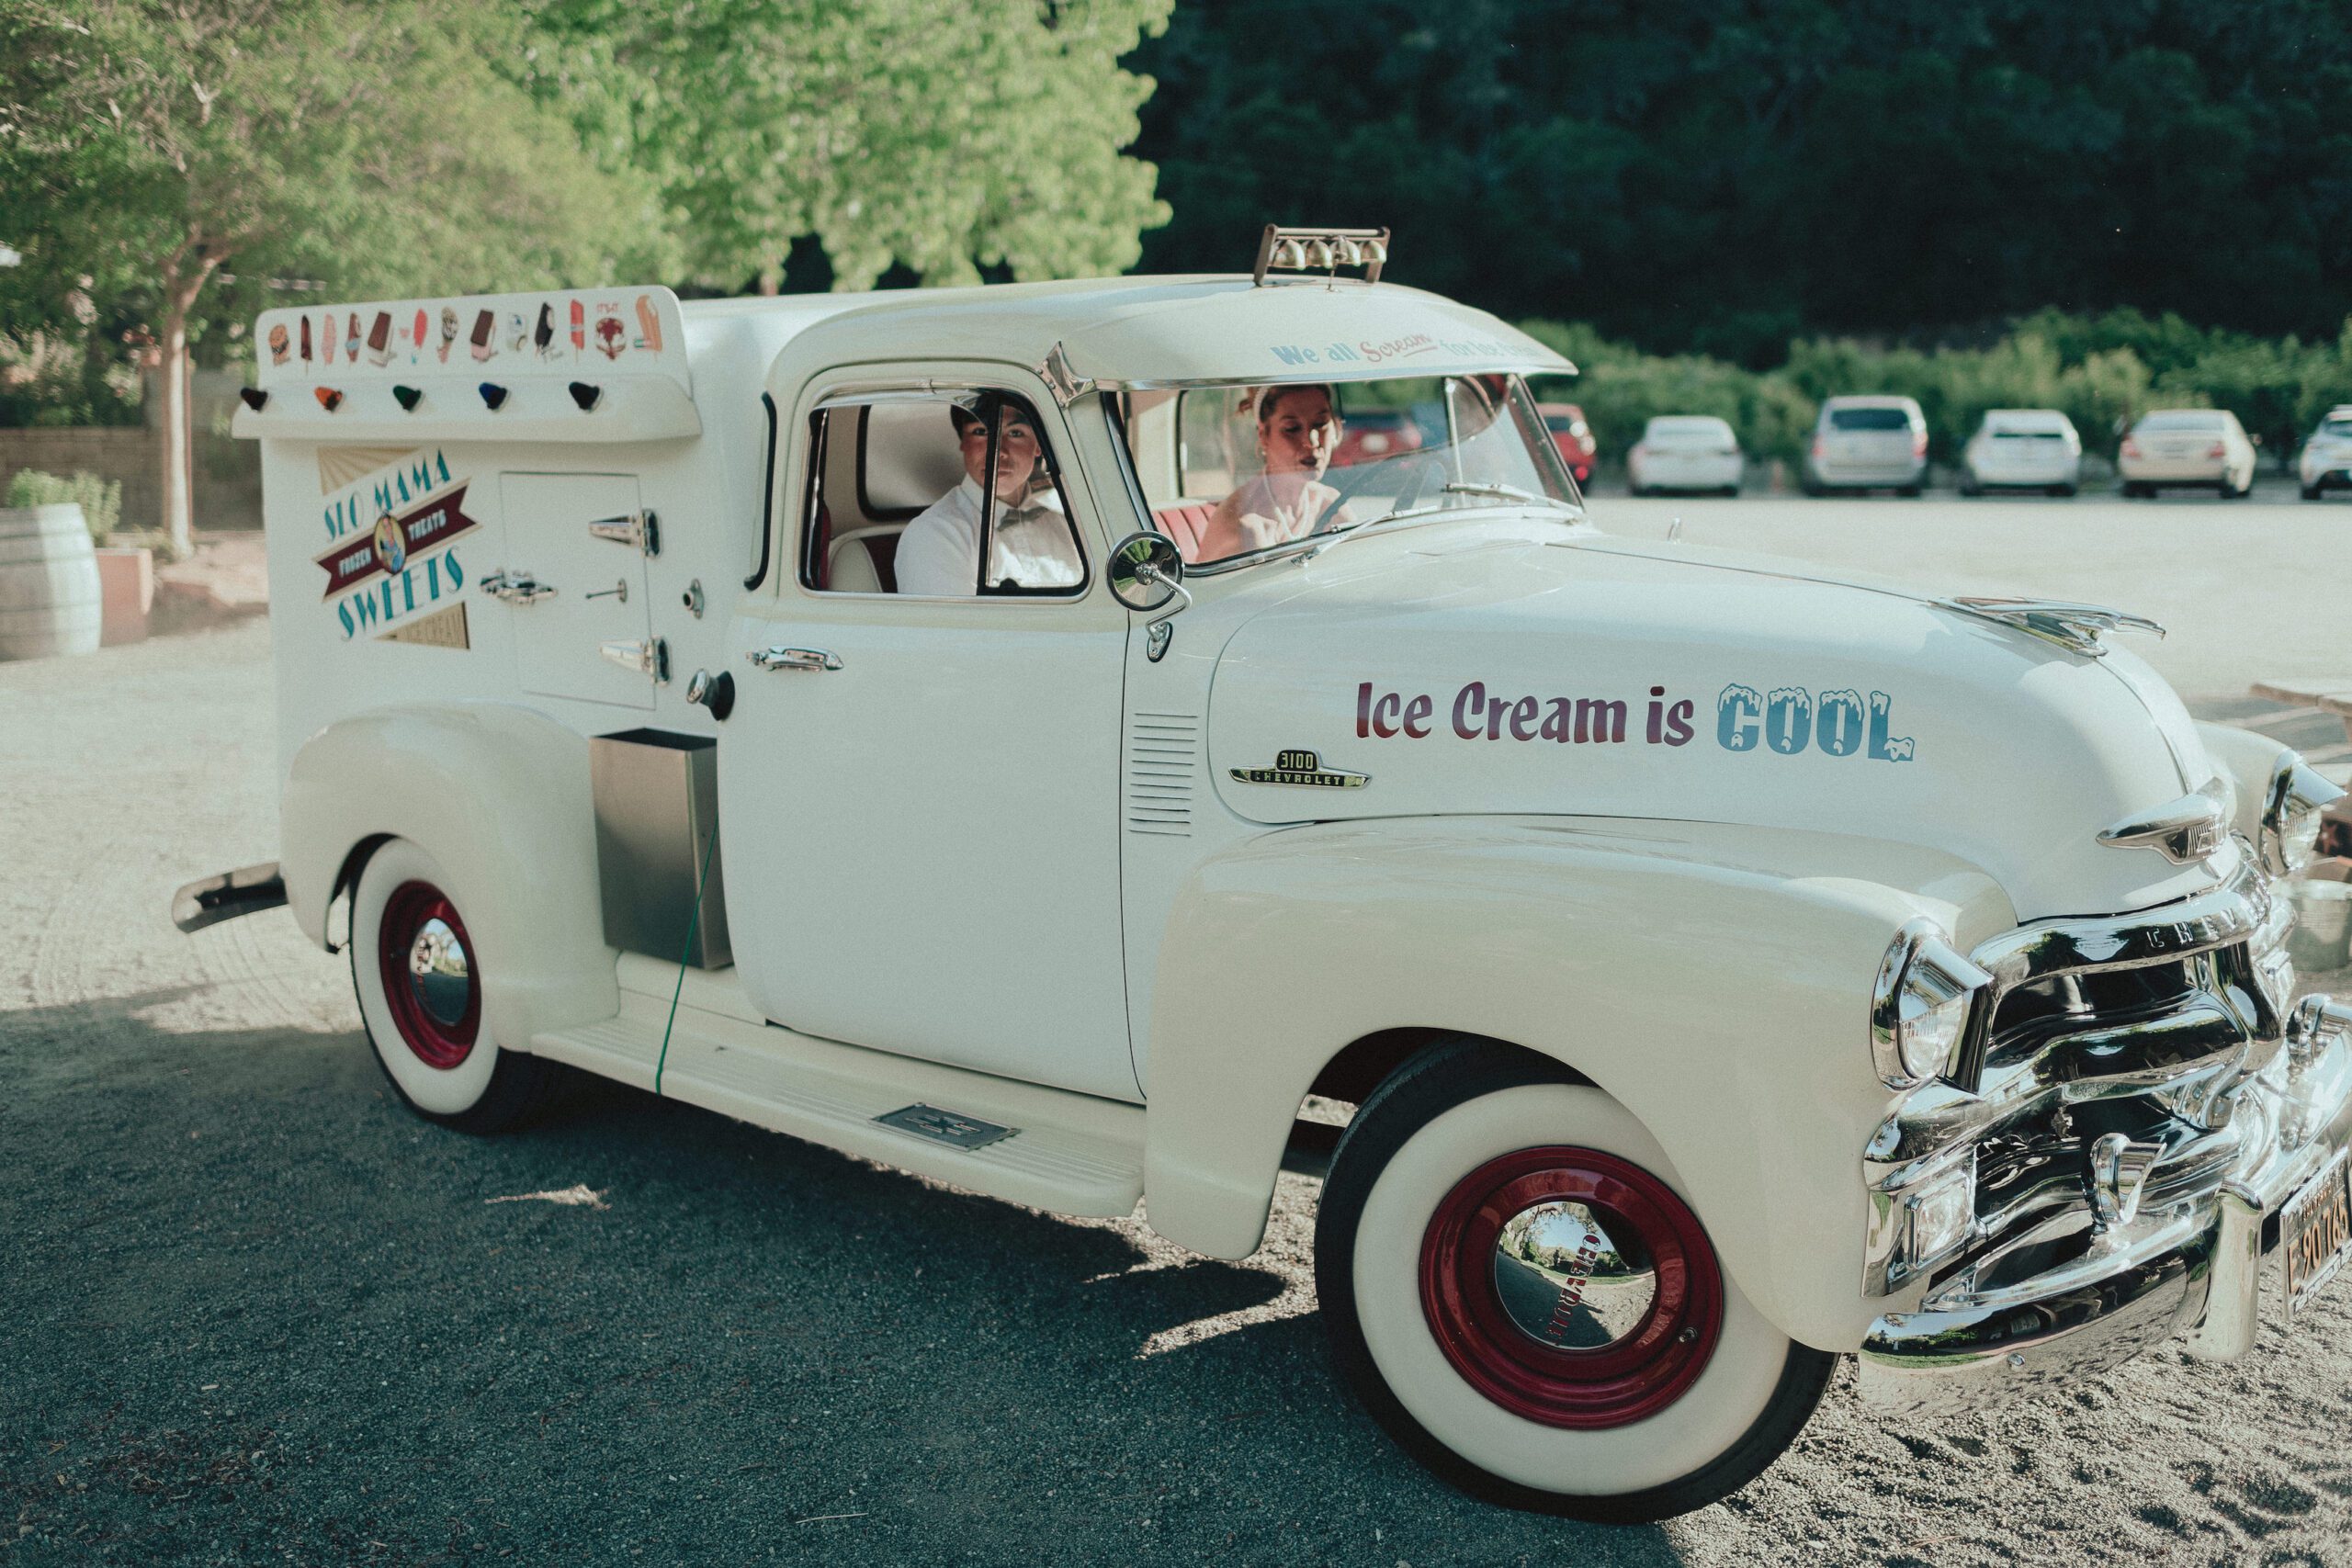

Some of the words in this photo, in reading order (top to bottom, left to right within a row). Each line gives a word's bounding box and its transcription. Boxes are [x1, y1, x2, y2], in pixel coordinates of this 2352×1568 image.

[1270, 345, 1319, 366] We
[1327, 343, 1360, 363] all
[1360, 332, 1434, 364] Scream
[323, 491, 365, 543] SLO
[372, 447, 451, 514] MAMA
[407, 509, 447, 542] TREATS
[337, 545, 465, 641] SWEETS
[1355, 681, 1433, 739] Ice
[1451, 680, 1627, 745] Cream
[1645, 685, 1695, 747] is
[1716, 682, 1915, 761] COOL
[1280, 752, 1315, 770] 3100
[1253, 771, 1341, 786] CHEVROLET
